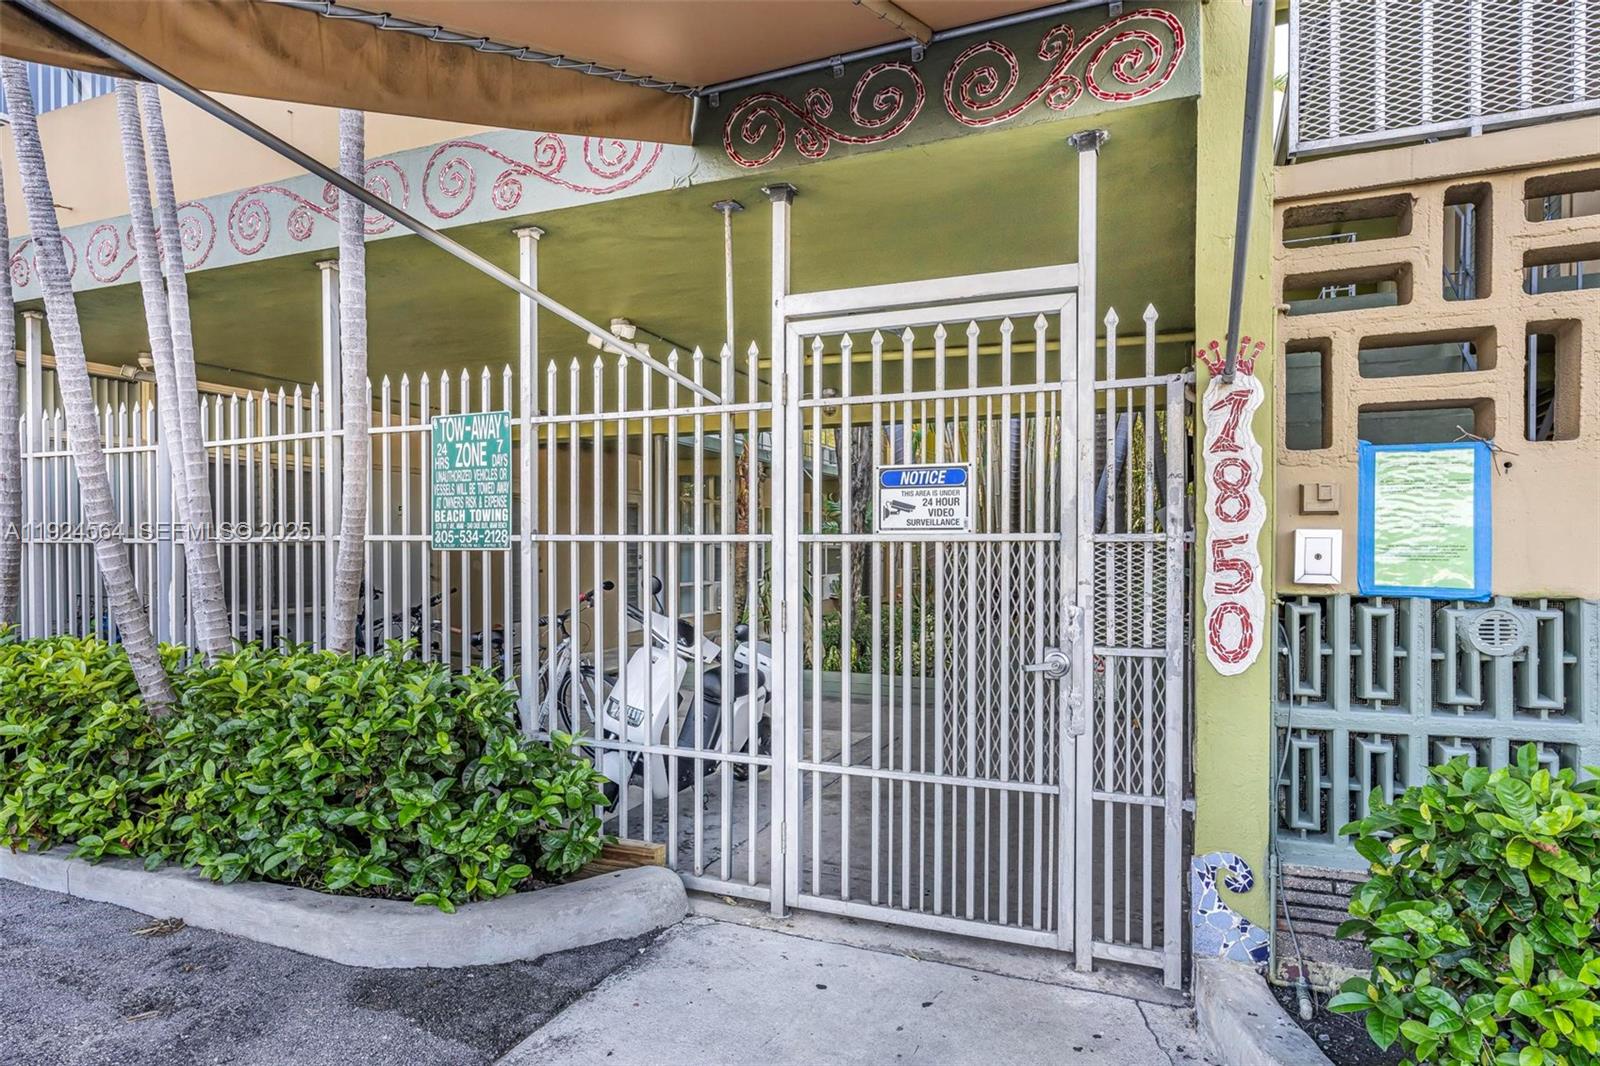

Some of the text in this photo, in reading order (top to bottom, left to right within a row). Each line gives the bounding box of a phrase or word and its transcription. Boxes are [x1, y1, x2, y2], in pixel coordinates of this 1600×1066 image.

[440, 414, 502, 442] TOW-AWAY
[436, 442, 448, 456] 24
[496, 439, 504, 453] 7
[455, 442, 487, 468] ZONE
[491, 453, 508, 467] DAYS
[434, 456, 450, 470] HRS
[436, 468, 507, 482] UNAUTHORIZED VEHICLES OR
[900, 470, 947, 485] NOTICE
[434, 481, 509, 496] VESSELS WILL BE TOWED AWAY
[436, 496, 442, 509] AT
[465, 495, 477, 508] RISK
[484, 494, 507, 508] EXPENSE
[922, 497, 960, 506] 24 HOUR
[434, 508, 509, 523] BEACH TOWING
[928, 508, 954, 517] VIDEO
[906, 518, 960, 526] SURVEILLANCE
